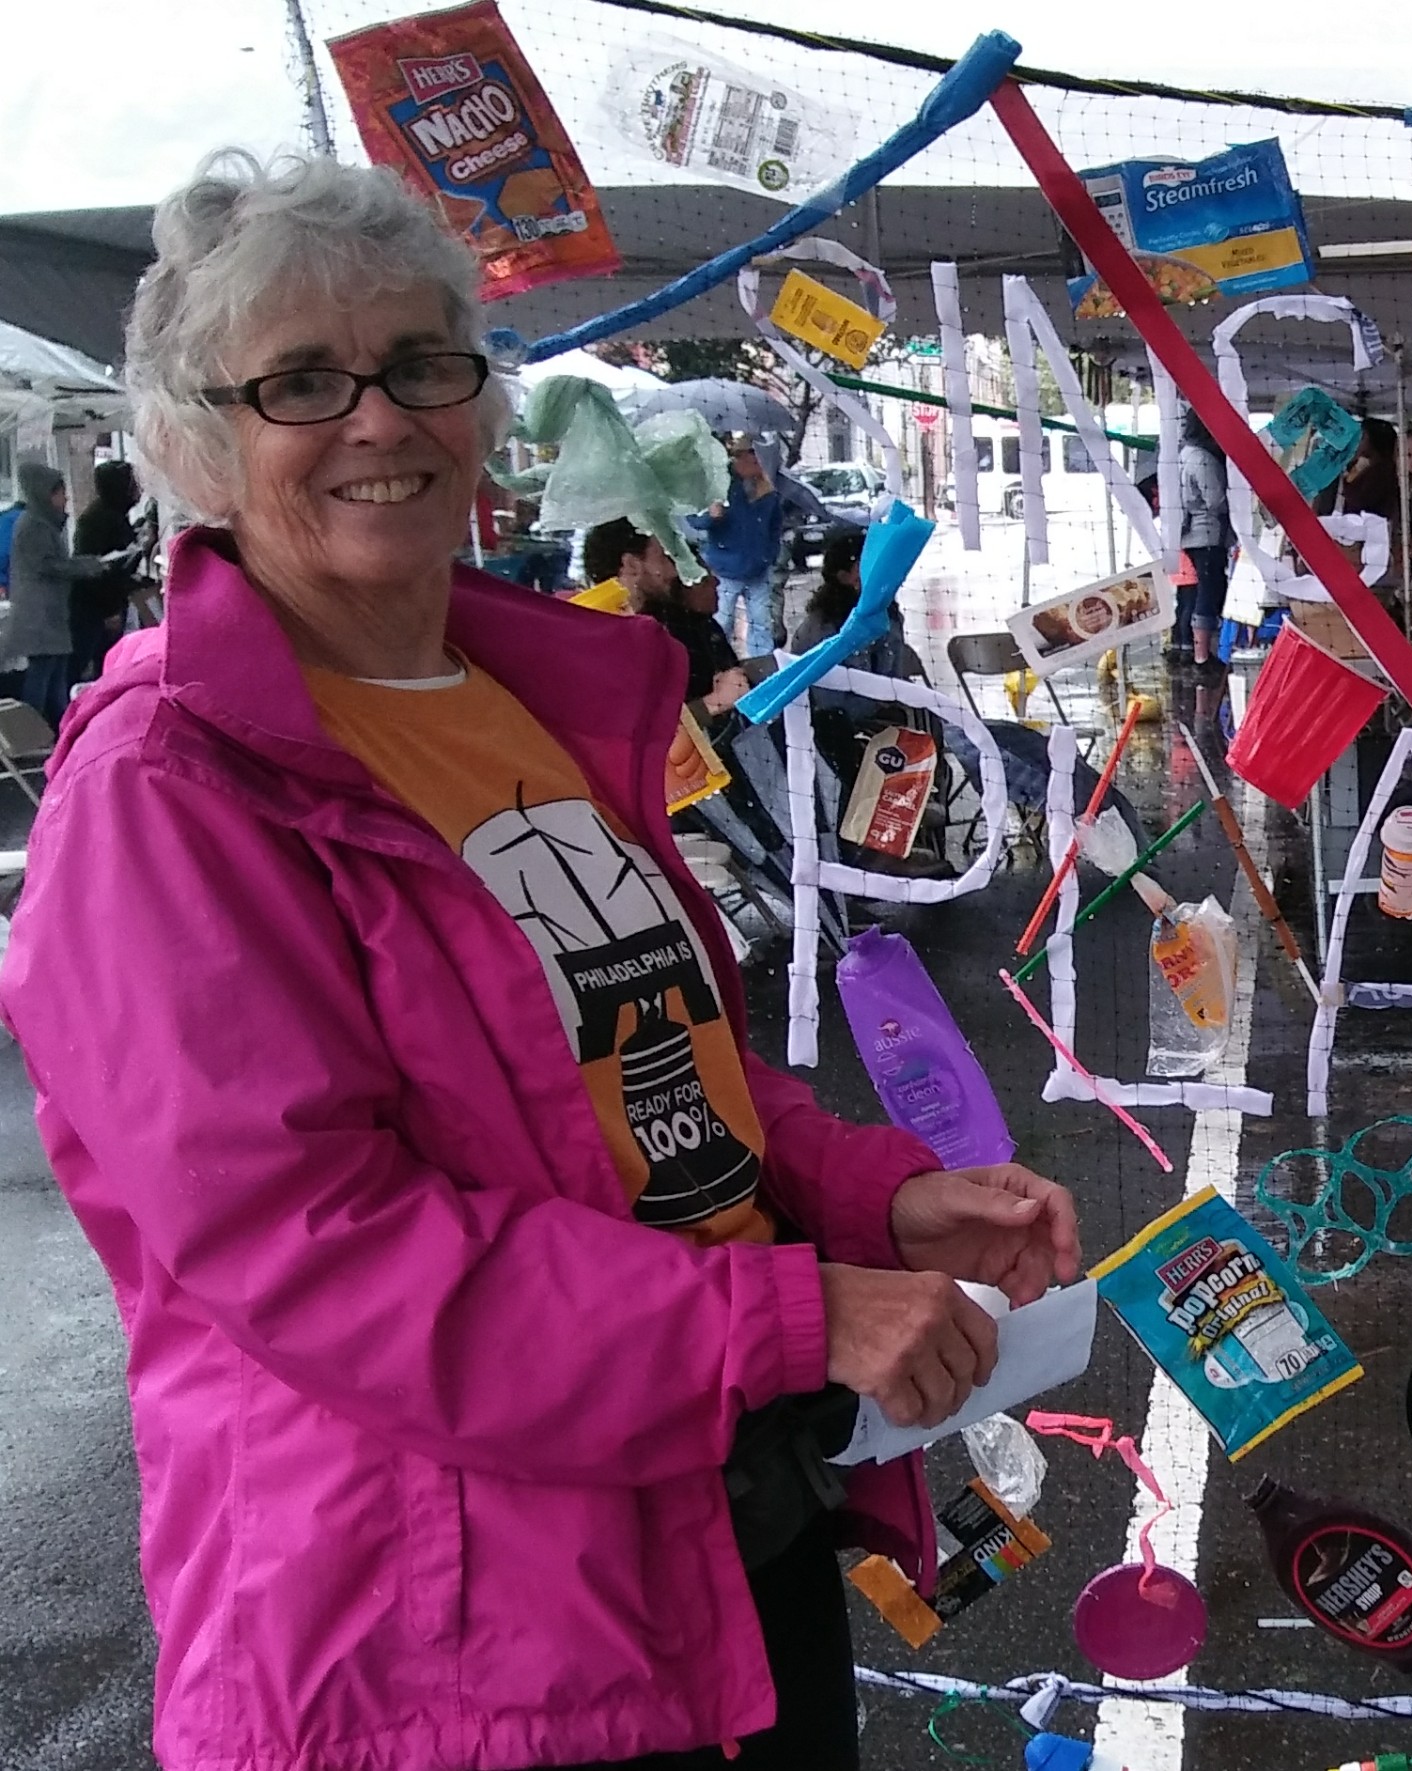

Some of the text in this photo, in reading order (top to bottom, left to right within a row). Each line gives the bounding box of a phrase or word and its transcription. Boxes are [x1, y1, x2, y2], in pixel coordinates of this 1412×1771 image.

[413, 59, 471, 88] HERR'S
[411, 85, 514, 155] NACHO
[1145, 166, 1258, 212] Steamfresh
[878, 753, 903, 768] GU
[573, 940, 693, 993] PHILADELPHIA IS
[874, 1026, 922, 1053] aussie
[626, 1080, 704, 1123] READY FOR
[907, 1083, 942, 1104] clean
[633, 1100, 726, 1163] 100%
[1165, 1242, 1217, 1285] HERR'S
[1202, 1281, 1270, 1339] Original
[1279, 1352, 1301, 1376] 70
[973, 1526, 1015, 1563] KIND
[1315, 1543, 1394, 1616] HERSHEY'S
[1355, 1582, 1384, 1612] SYRUP
